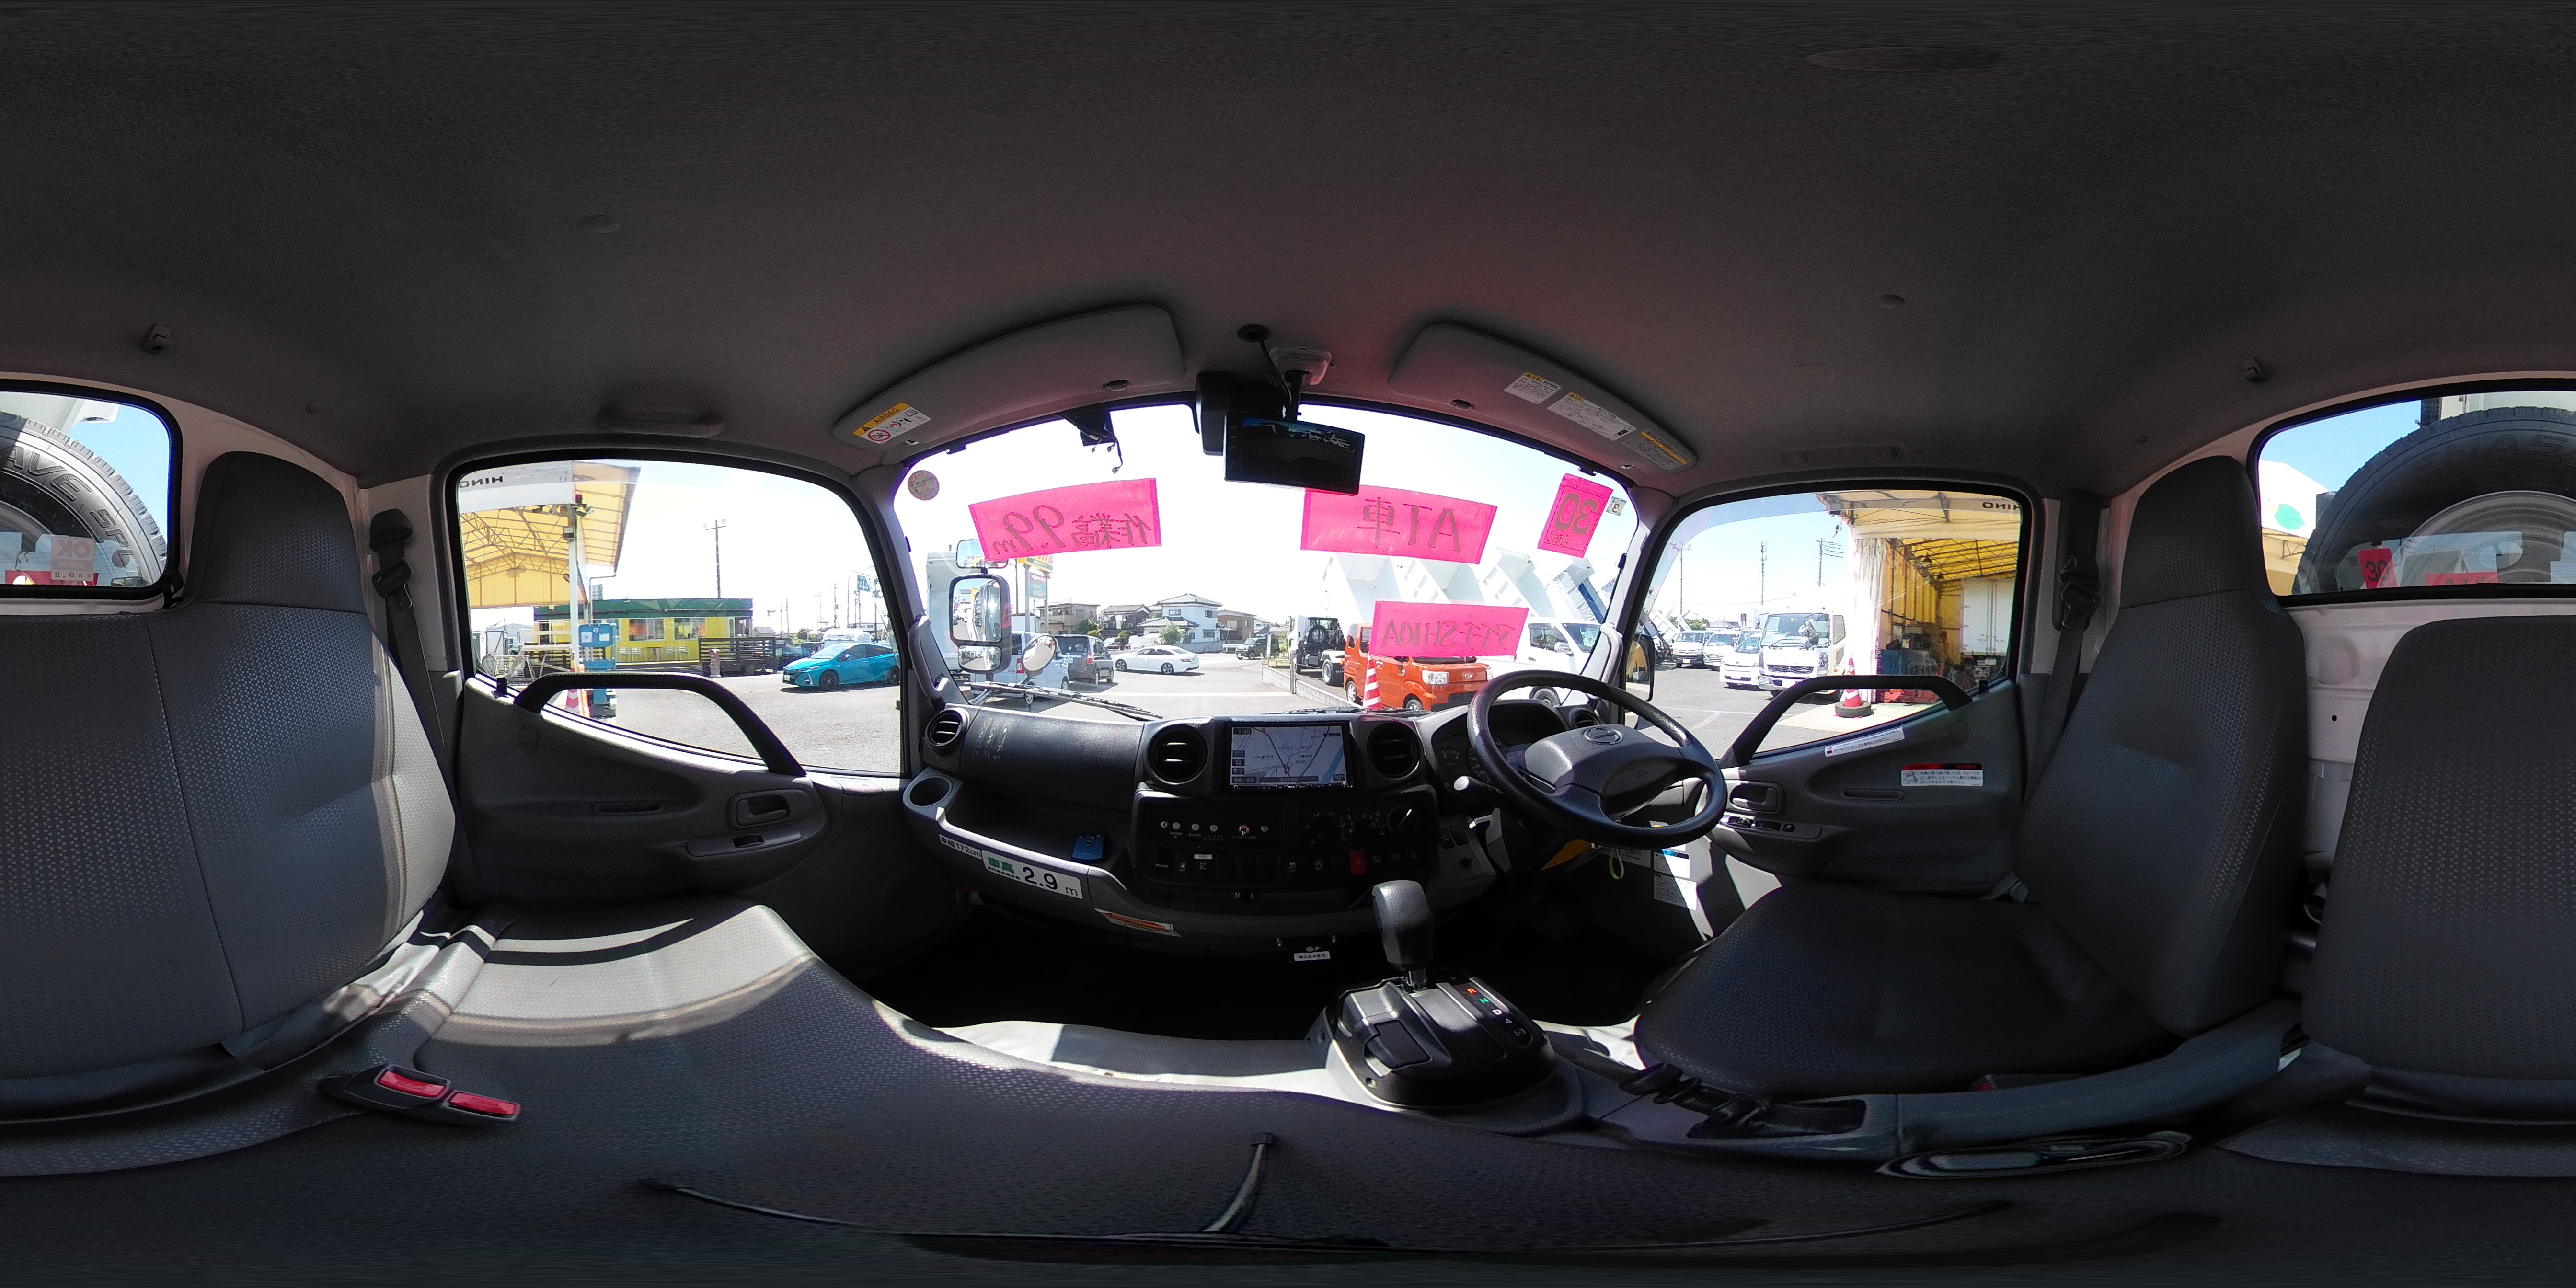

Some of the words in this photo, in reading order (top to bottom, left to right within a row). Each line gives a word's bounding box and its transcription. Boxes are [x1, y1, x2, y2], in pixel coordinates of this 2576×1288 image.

[874, 408, 900, 424] AIRBAG
[90, 508, 135, 568] SPL
[987, 856, 1015, 874] 車高
[1022, 866, 1058, 890] 2.9
[1065, 886, 1079, 897] m
